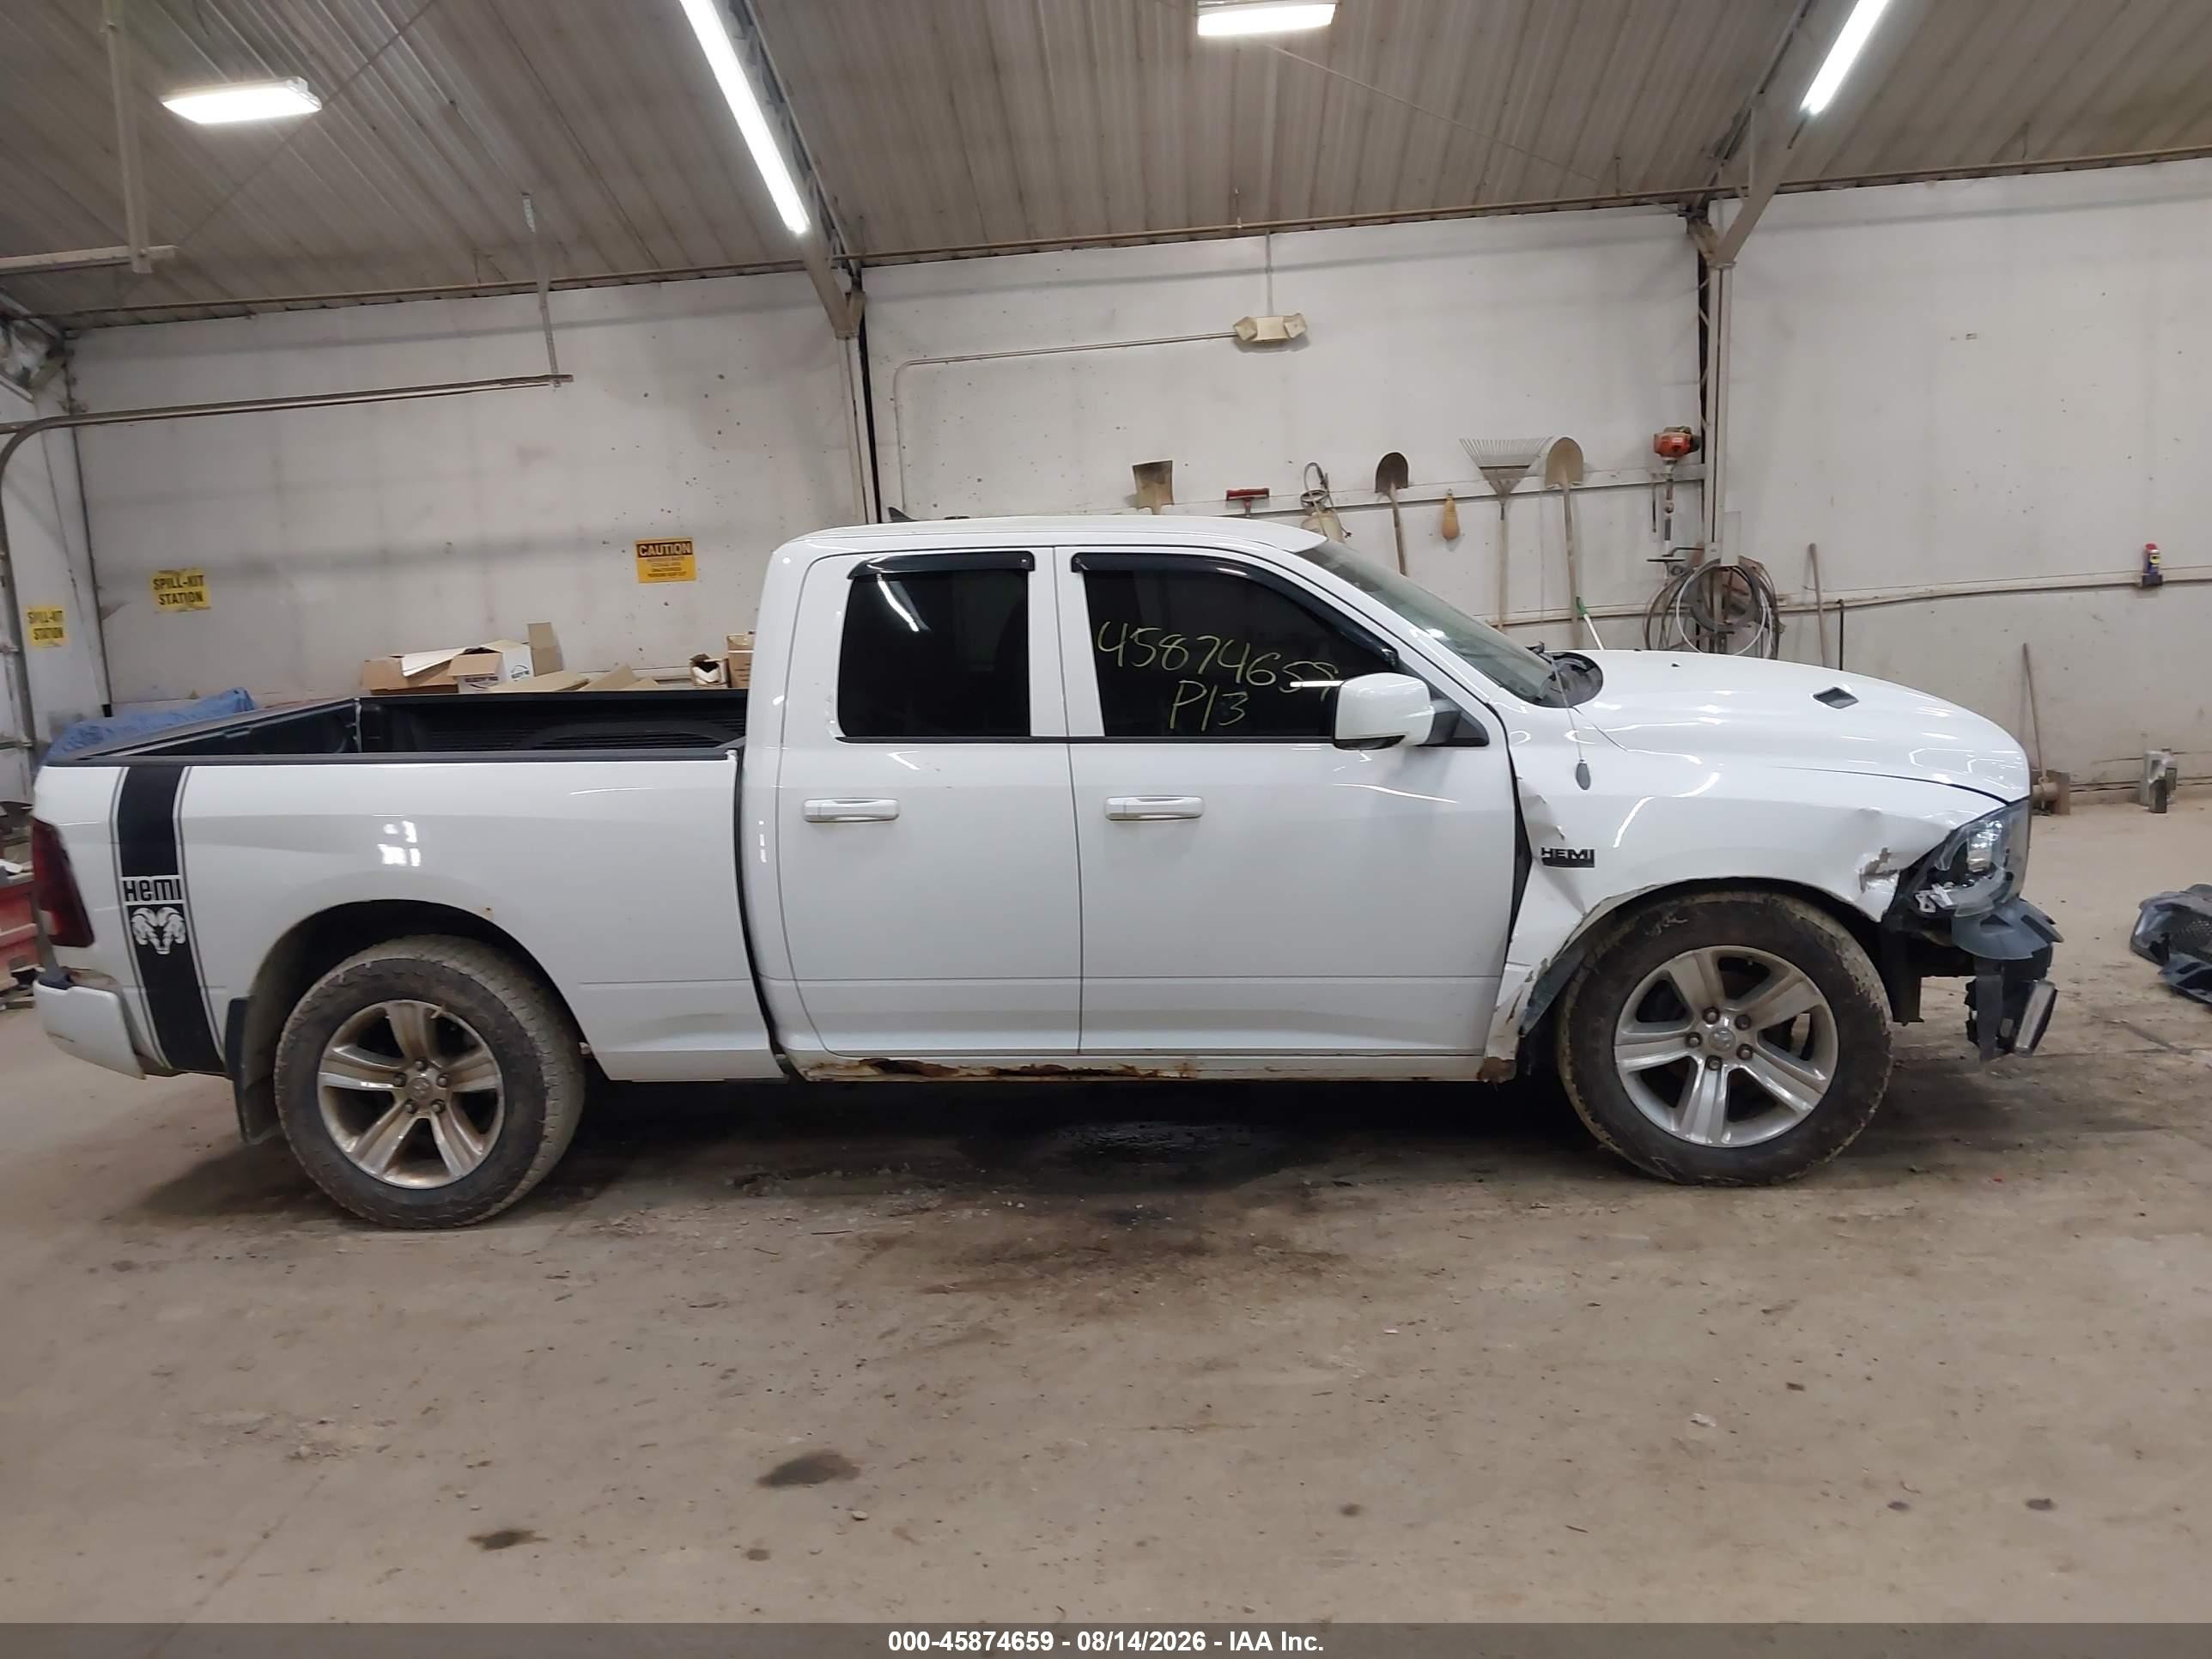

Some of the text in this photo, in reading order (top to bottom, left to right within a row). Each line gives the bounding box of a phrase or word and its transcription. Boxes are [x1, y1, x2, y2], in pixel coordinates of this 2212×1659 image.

[639, 543, 691, 556] CAUTION
[153, 574, 204, 591] SPILL-KIT
[158, 591, 204, 606] STATION
[1169, 679, 1249, 732] P13
[1540, 847, 1595, 861] HEMI
